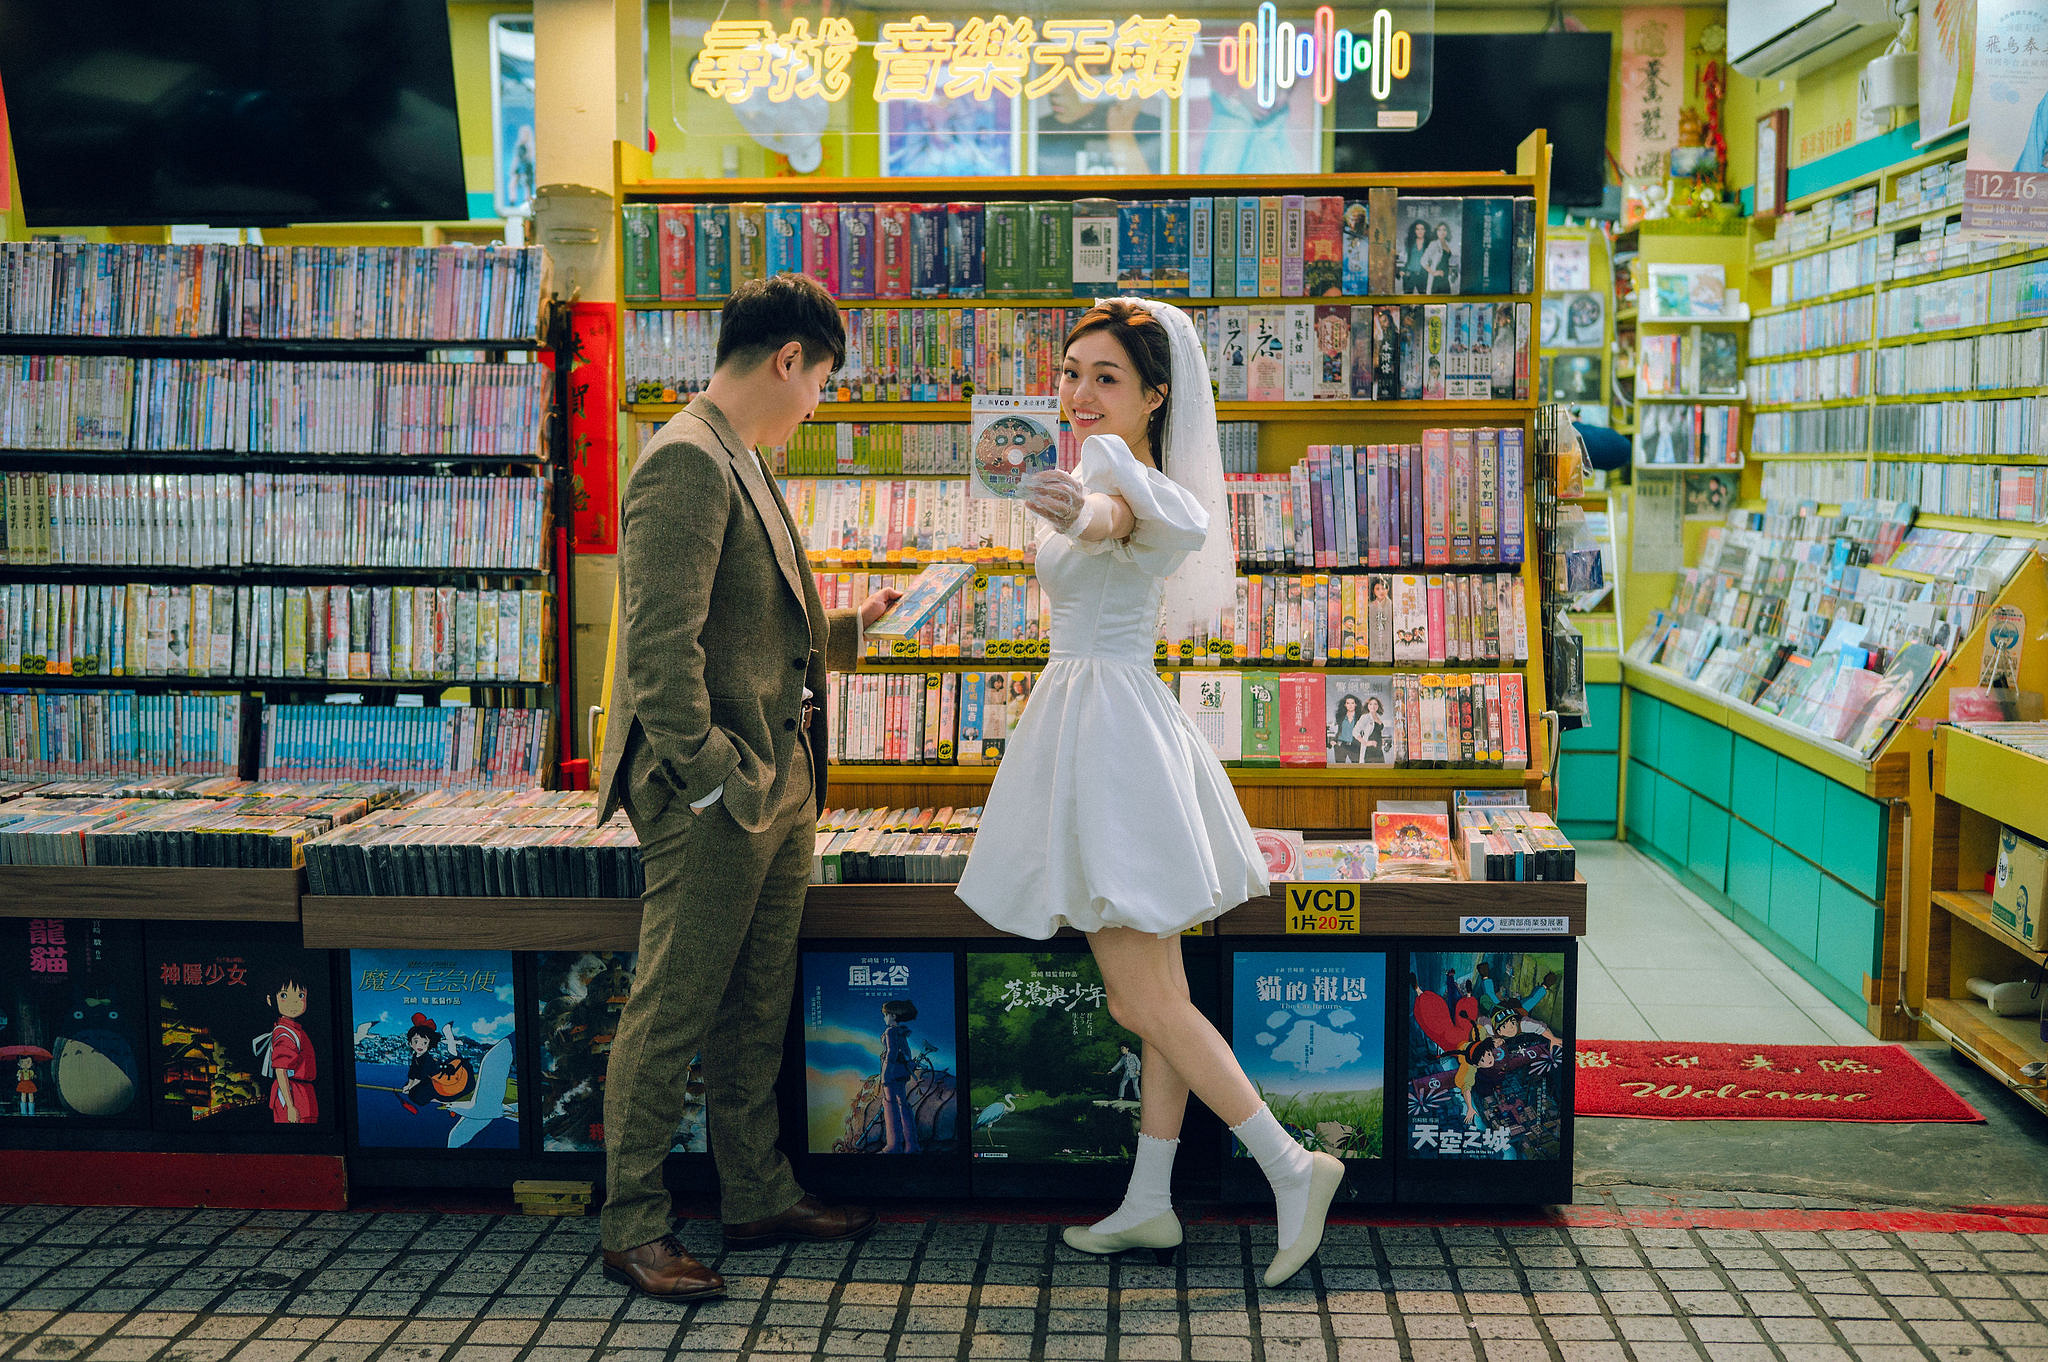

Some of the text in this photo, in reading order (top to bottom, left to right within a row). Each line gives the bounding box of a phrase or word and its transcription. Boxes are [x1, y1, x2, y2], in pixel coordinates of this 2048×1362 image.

[691, 16, 1200, 103] 尋找 音樂天籟
[1290, 889, 1355, 912] VCD
[1290, 914, 1355, 931] 1片20元
[1500, 918, 1563, 927] 經濟部商業發展署
[160, 963, 248, 986] 神隱少女
[358, 968, 498, 992] 魔女宅急便
[848, 965, 910, 987] 風之谷
[1001, 978, 1107, 1012] 蒼鷺與少年
[1256, 976, 1368, 1002] 貓的報恩
[1620, 1081, 1872, 1104] Welcome
[1411, 1123, 1512, 1154] 天空之城
